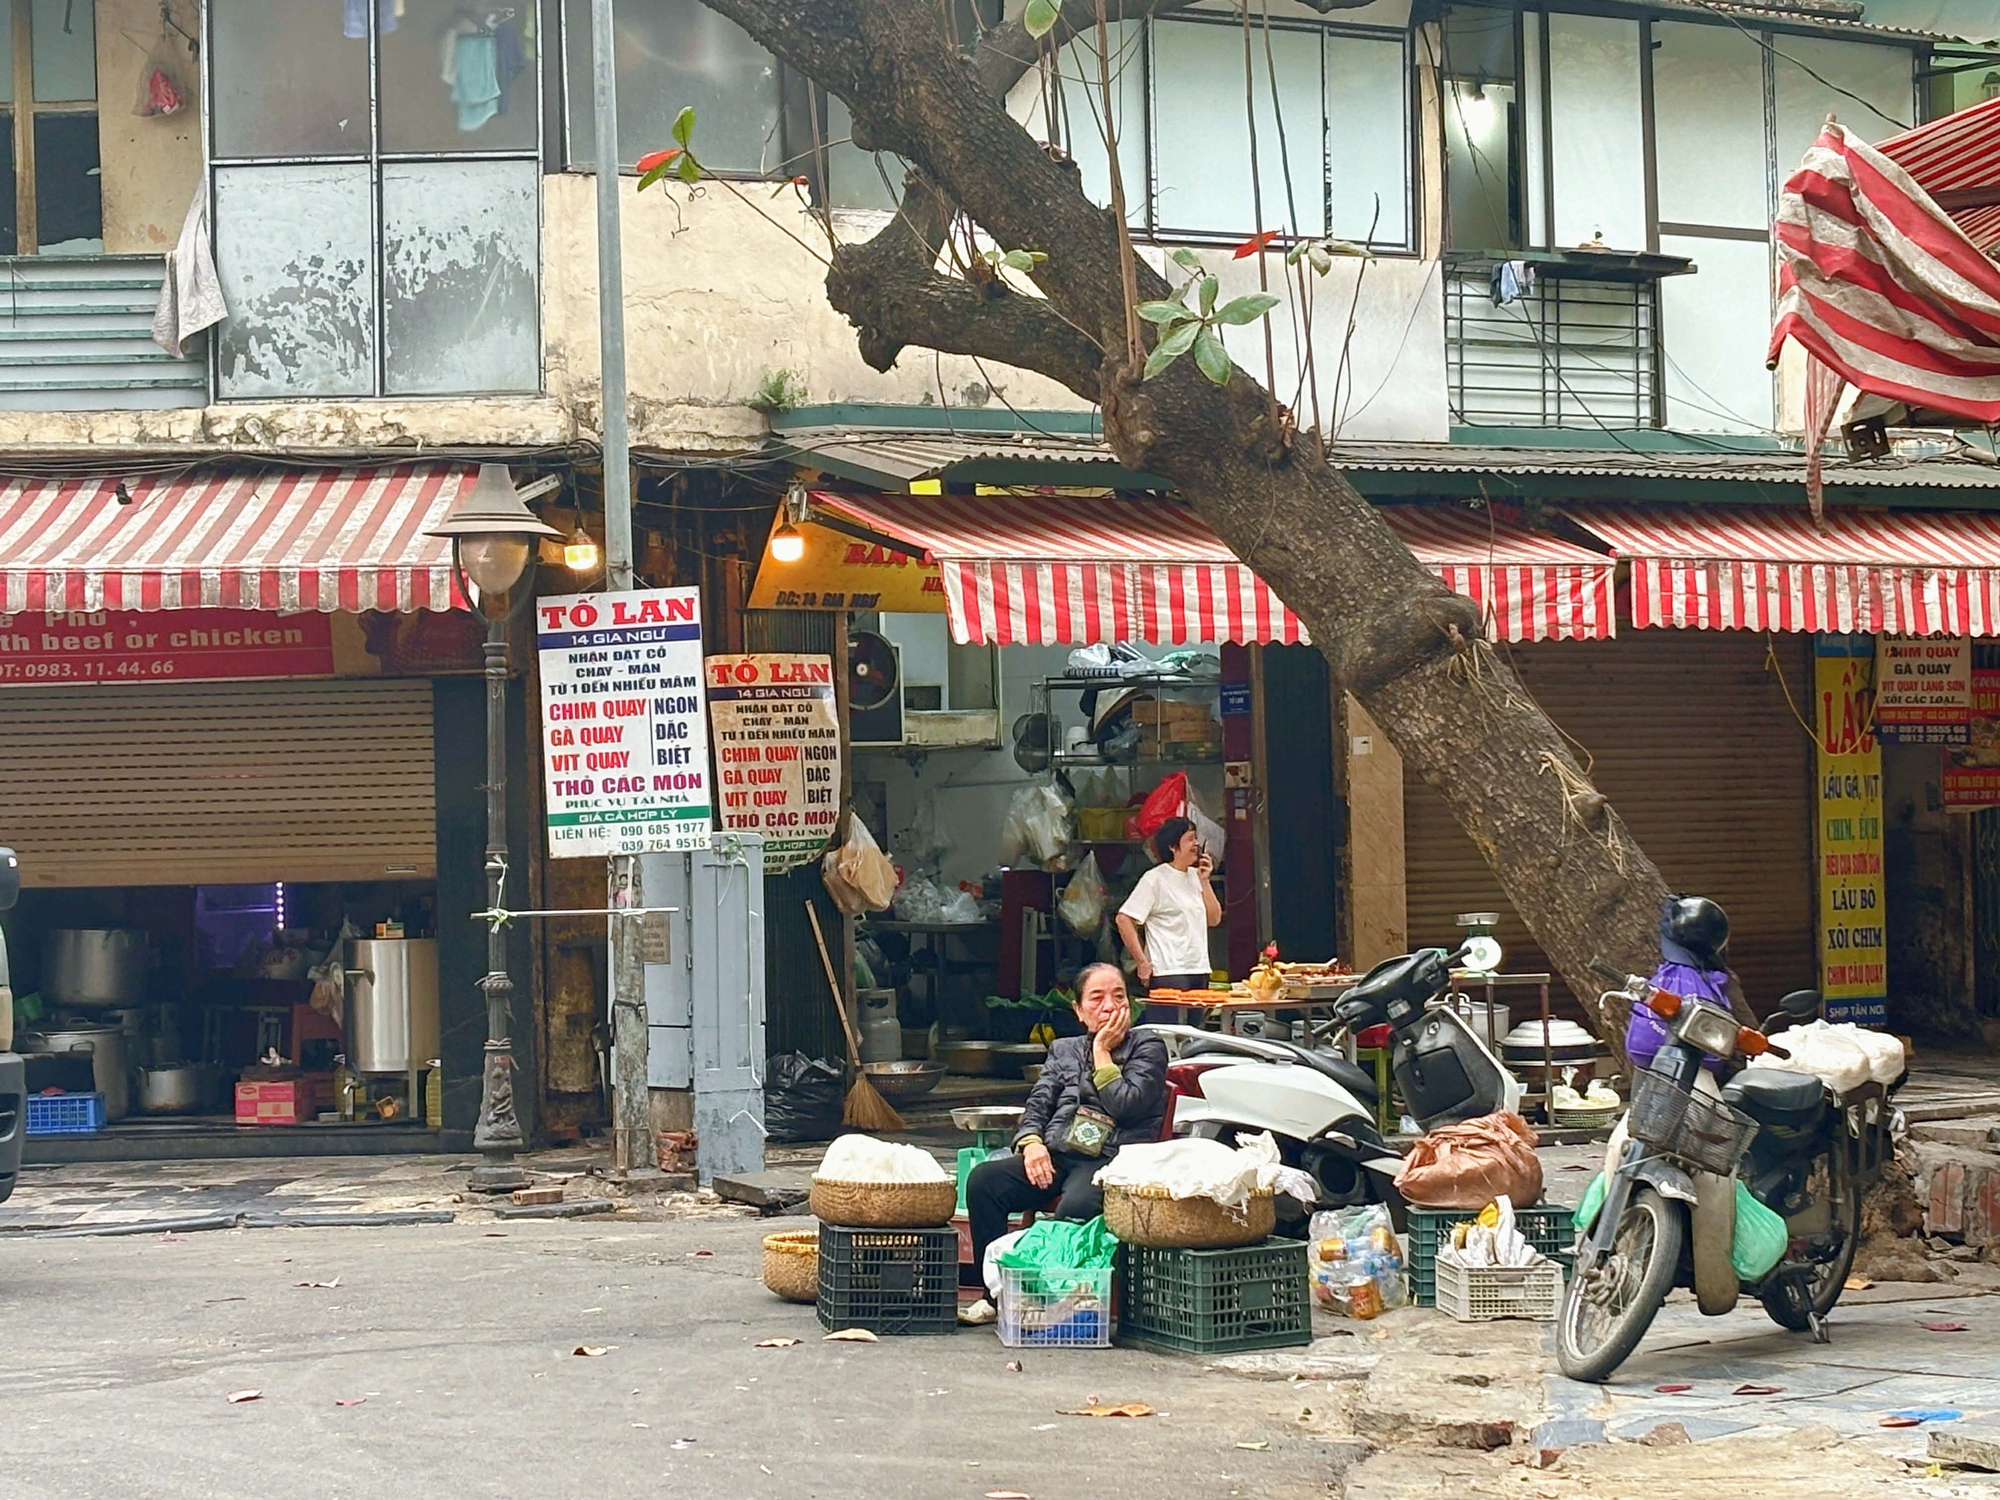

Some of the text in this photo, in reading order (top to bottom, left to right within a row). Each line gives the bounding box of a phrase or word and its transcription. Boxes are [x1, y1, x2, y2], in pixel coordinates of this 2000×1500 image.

[541, 595, 695, 629] TỐ LAN
[41, 632, 114, 651] beef
[125, 633, 158, 649] or
[169, 627, 303, 647] chicken
[571, 628, 667, 645] 14 GIA NGƯ
[1926, 647, 1960, 659] QUAY
[25, 662, 78, 678] 0983.
[84, 662, 112, 677] 11.
[116, 661, 146, 676] 44.
[150, 660, 175, 675] 66
[576, 666, 613, 678] CHAY
[711, 656, 829, 684] TỐ LAN
[1894, 662, 1951, 676] GÀ QUAY
[548, 682, 567, 695] TỪ
[571, 684, 578, 694] 1
[581, 678, 609, 694] ĐẾN
[660, 676, 697, 688] MÂM
[737, 690, 753, 698] 14
[755, 689, 779, 698] GIA
[1882, 681, 1895, 694] VỊT
[1897, 681, 1919, 693] QUAY
[1921, 681, 1944, 694] LẠNG
[654, 696, 698, 715] NGON
[1883, 695, 1902, 705] XÔI
[1905, 695, 1926, 704] CÁC
[549, 698, 647, 721] CHIM QUAY
[742, 717, 772, 726] CHAY
[550, 725, 624, 746] GÀ QUAY
[655, 719, 688, 743] ĐẶC
[739, 731, 745, 740] 1
[657, 745, 692, 768] BIỆT
[722, 746, 799, 763] CHIM QUAY
[804, 745, 837, 760] NGON
[551, 751, 630, 775] VỊT QUAY
[552, 771, 702, 797] THỎ CÁC MÓN
[747, 768, 782, 785] QUAY
[608, 797, 626, 809] VỤ
[631, 796, 655, 808] TẠI
[660, 792, 690, 804] NHÀ
[753, 790, 787, 807] QUAY
[807, 786, 832, 806] BIỆT
[578, 808, 678, 823] GIÁ CẢ HỢP LÝ
[804, 808, 837, 825] MÓN
[555, 825, 611, 842] LIÊN HỆ:
[621, 822, 705, 837] 090 685 1977
[1826, 817, 1855, 842] CHIM,
[621, 838, 706, 851] 039 764 9515
[1860, 882, 1876, 909] BÒ
[1828, 922, 1882, 949] XÔI CHIM
[1827, 965, 1847, 986] CHIM
[1829, 1007, 1849, 1018] SHIP
